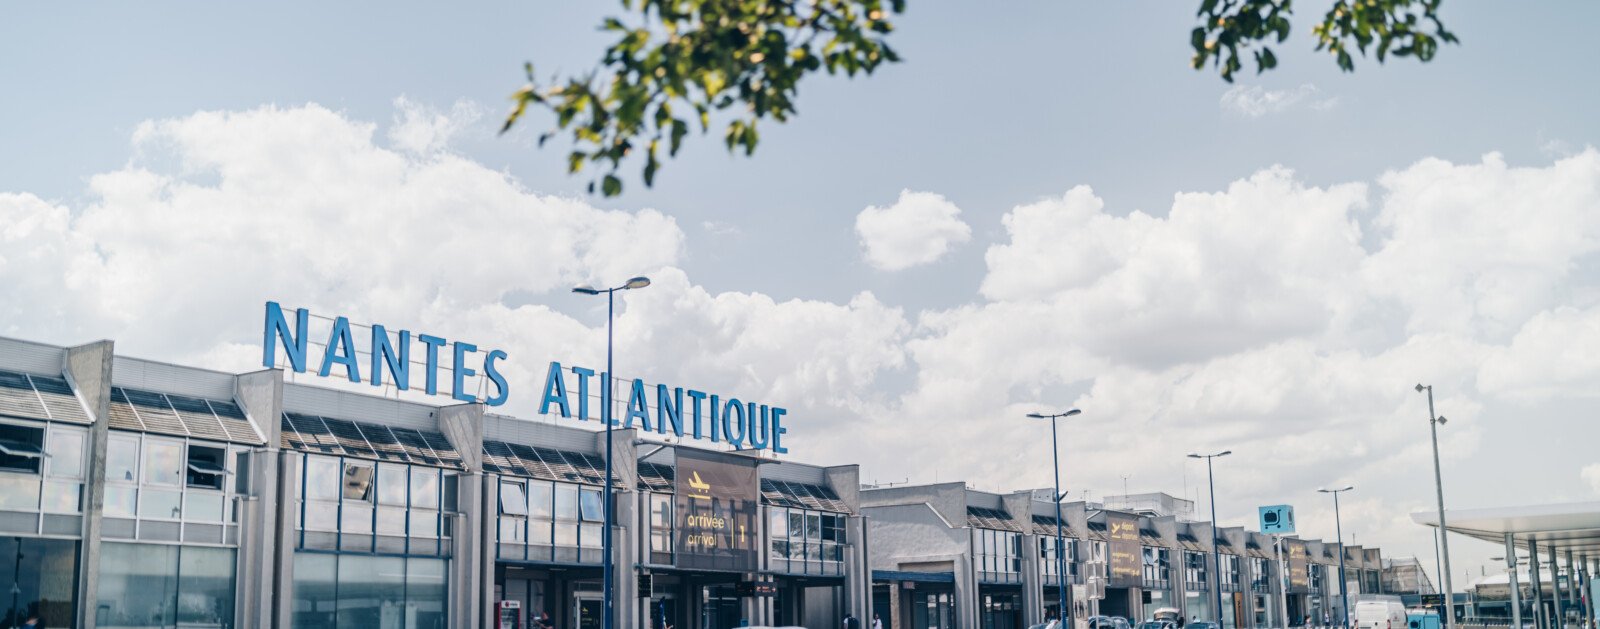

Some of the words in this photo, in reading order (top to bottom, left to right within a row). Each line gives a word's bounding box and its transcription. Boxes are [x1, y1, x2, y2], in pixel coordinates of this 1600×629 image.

[263, 301, 510, 407] NANTES
[537, 361, 788, 454] ATLANTIQUE
[687, 513, 724, 529] arrivée
[687, 532, 717, 546] arrival
[739, 525, 745, 543] 1
